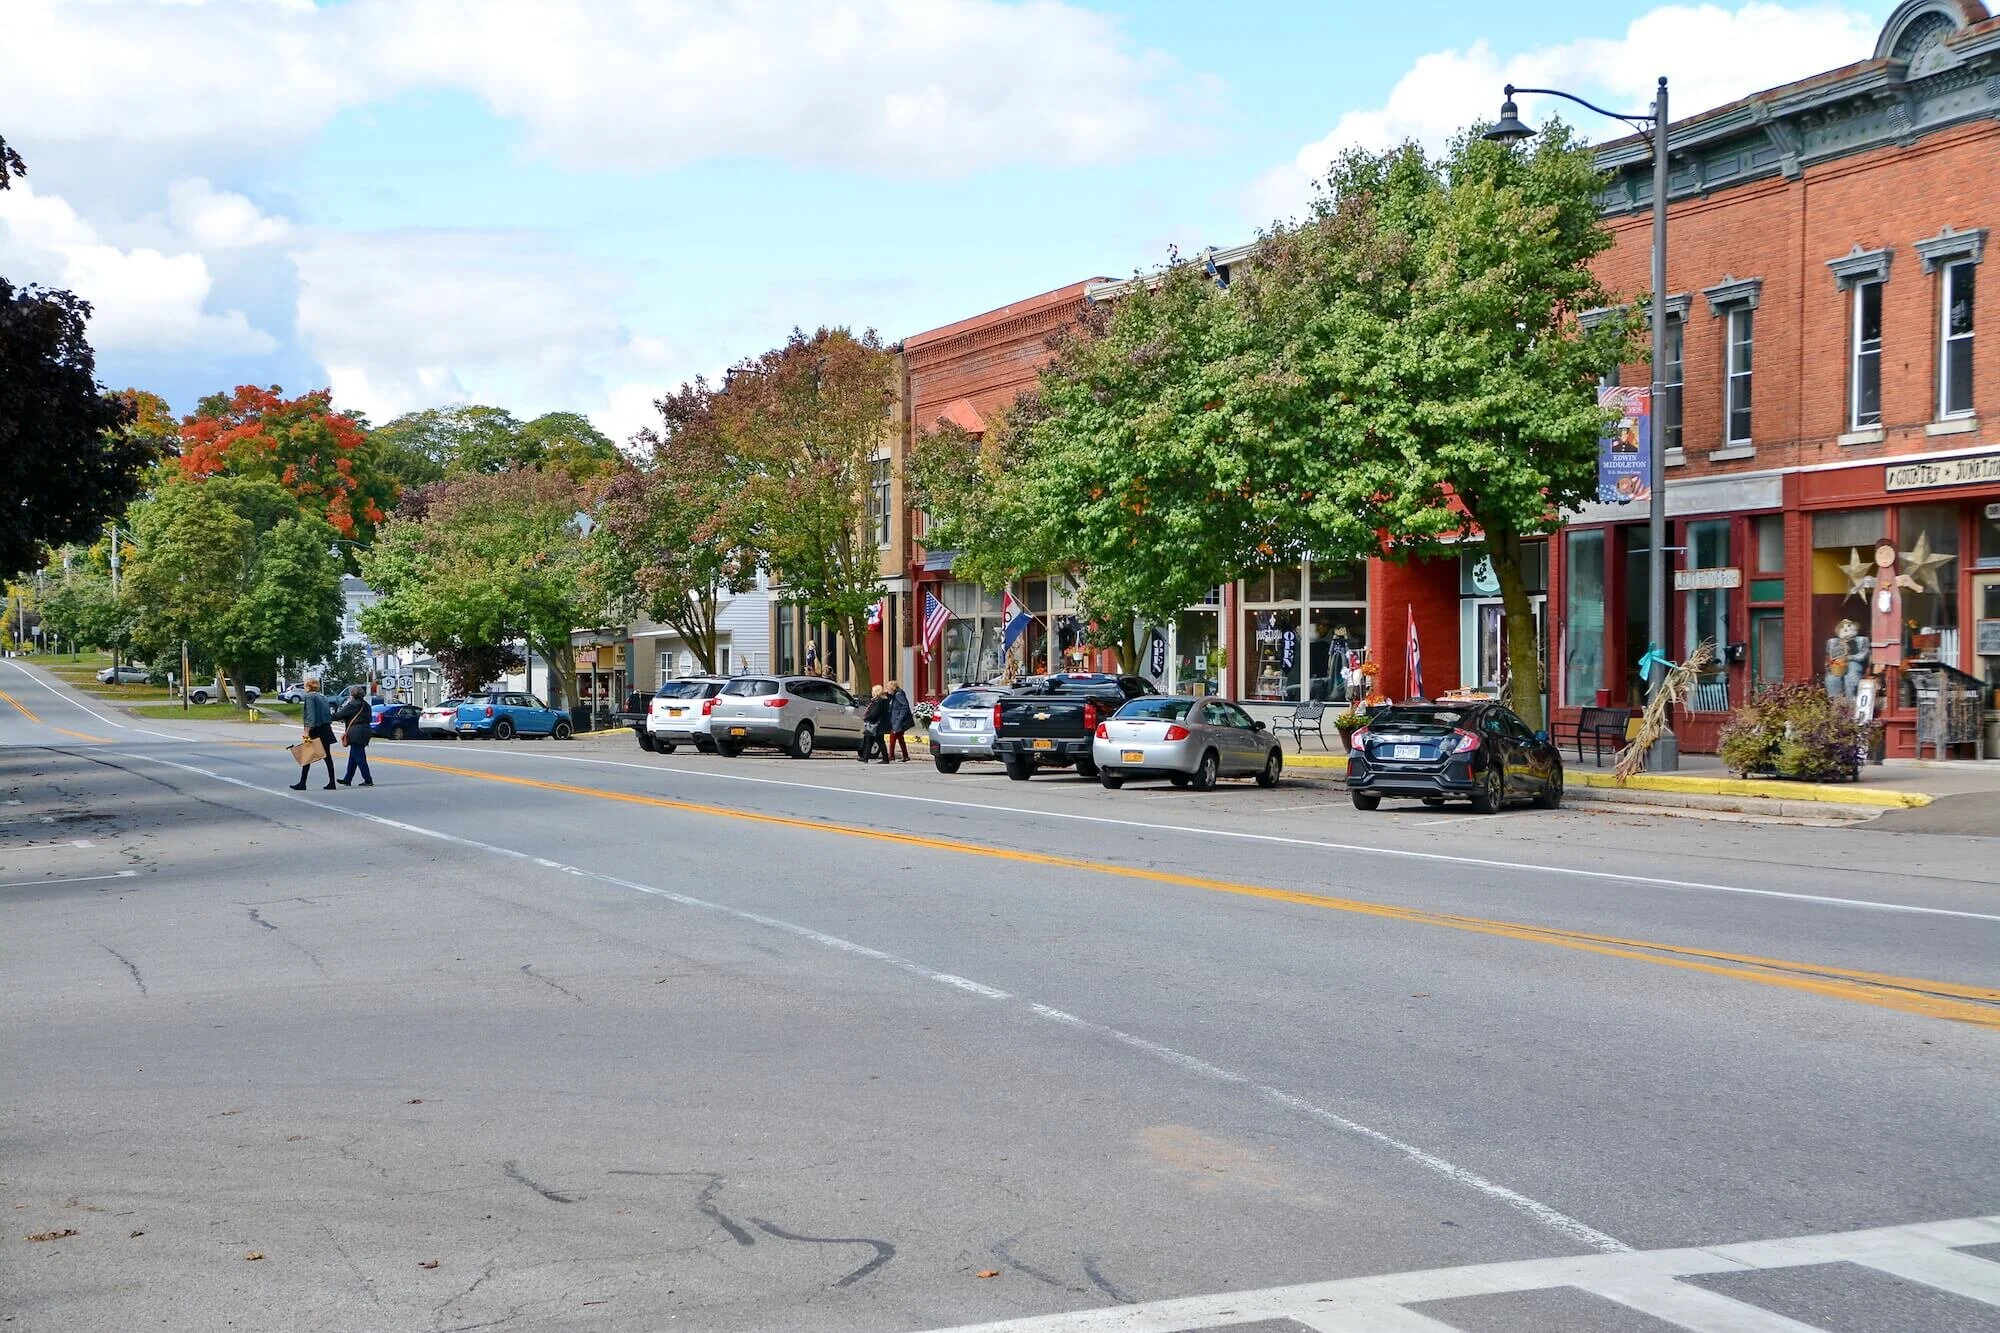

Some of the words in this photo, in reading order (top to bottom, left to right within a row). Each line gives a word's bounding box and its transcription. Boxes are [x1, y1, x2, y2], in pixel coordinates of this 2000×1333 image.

[1897, 465, 1940, 486] COUNTRY
[1153, 639, 1164, 672] OPEN
[1282, 631, 1295, 668] OPEN
[386, 678, 392, 687] 5
[400, 678, 412, 687] 36
